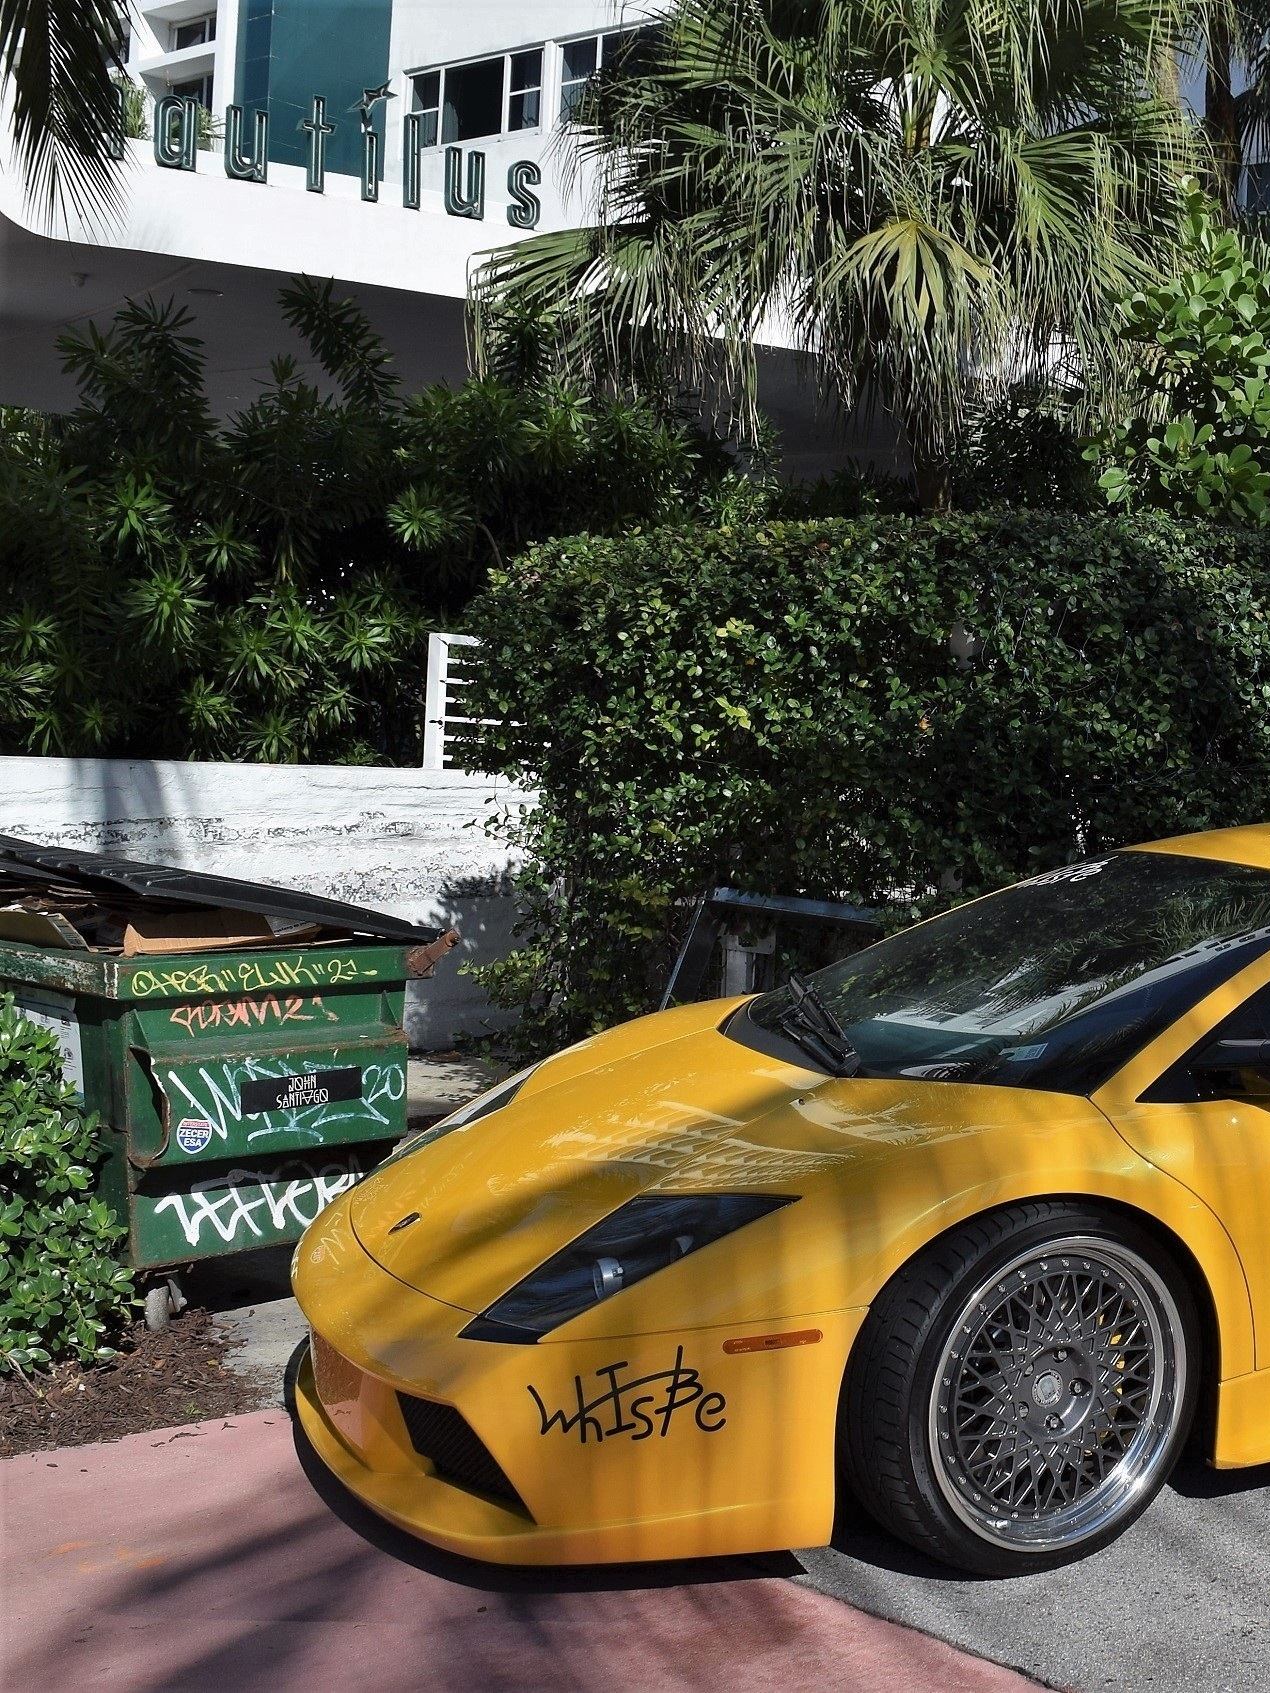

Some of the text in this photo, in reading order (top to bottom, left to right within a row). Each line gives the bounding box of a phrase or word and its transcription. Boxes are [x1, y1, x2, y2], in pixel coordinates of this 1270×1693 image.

[288, 1075, 317, 1091] JOHN
[179, 1129, 209, 1138] ZECER
[184, 1138, 202, 1147] ESA
